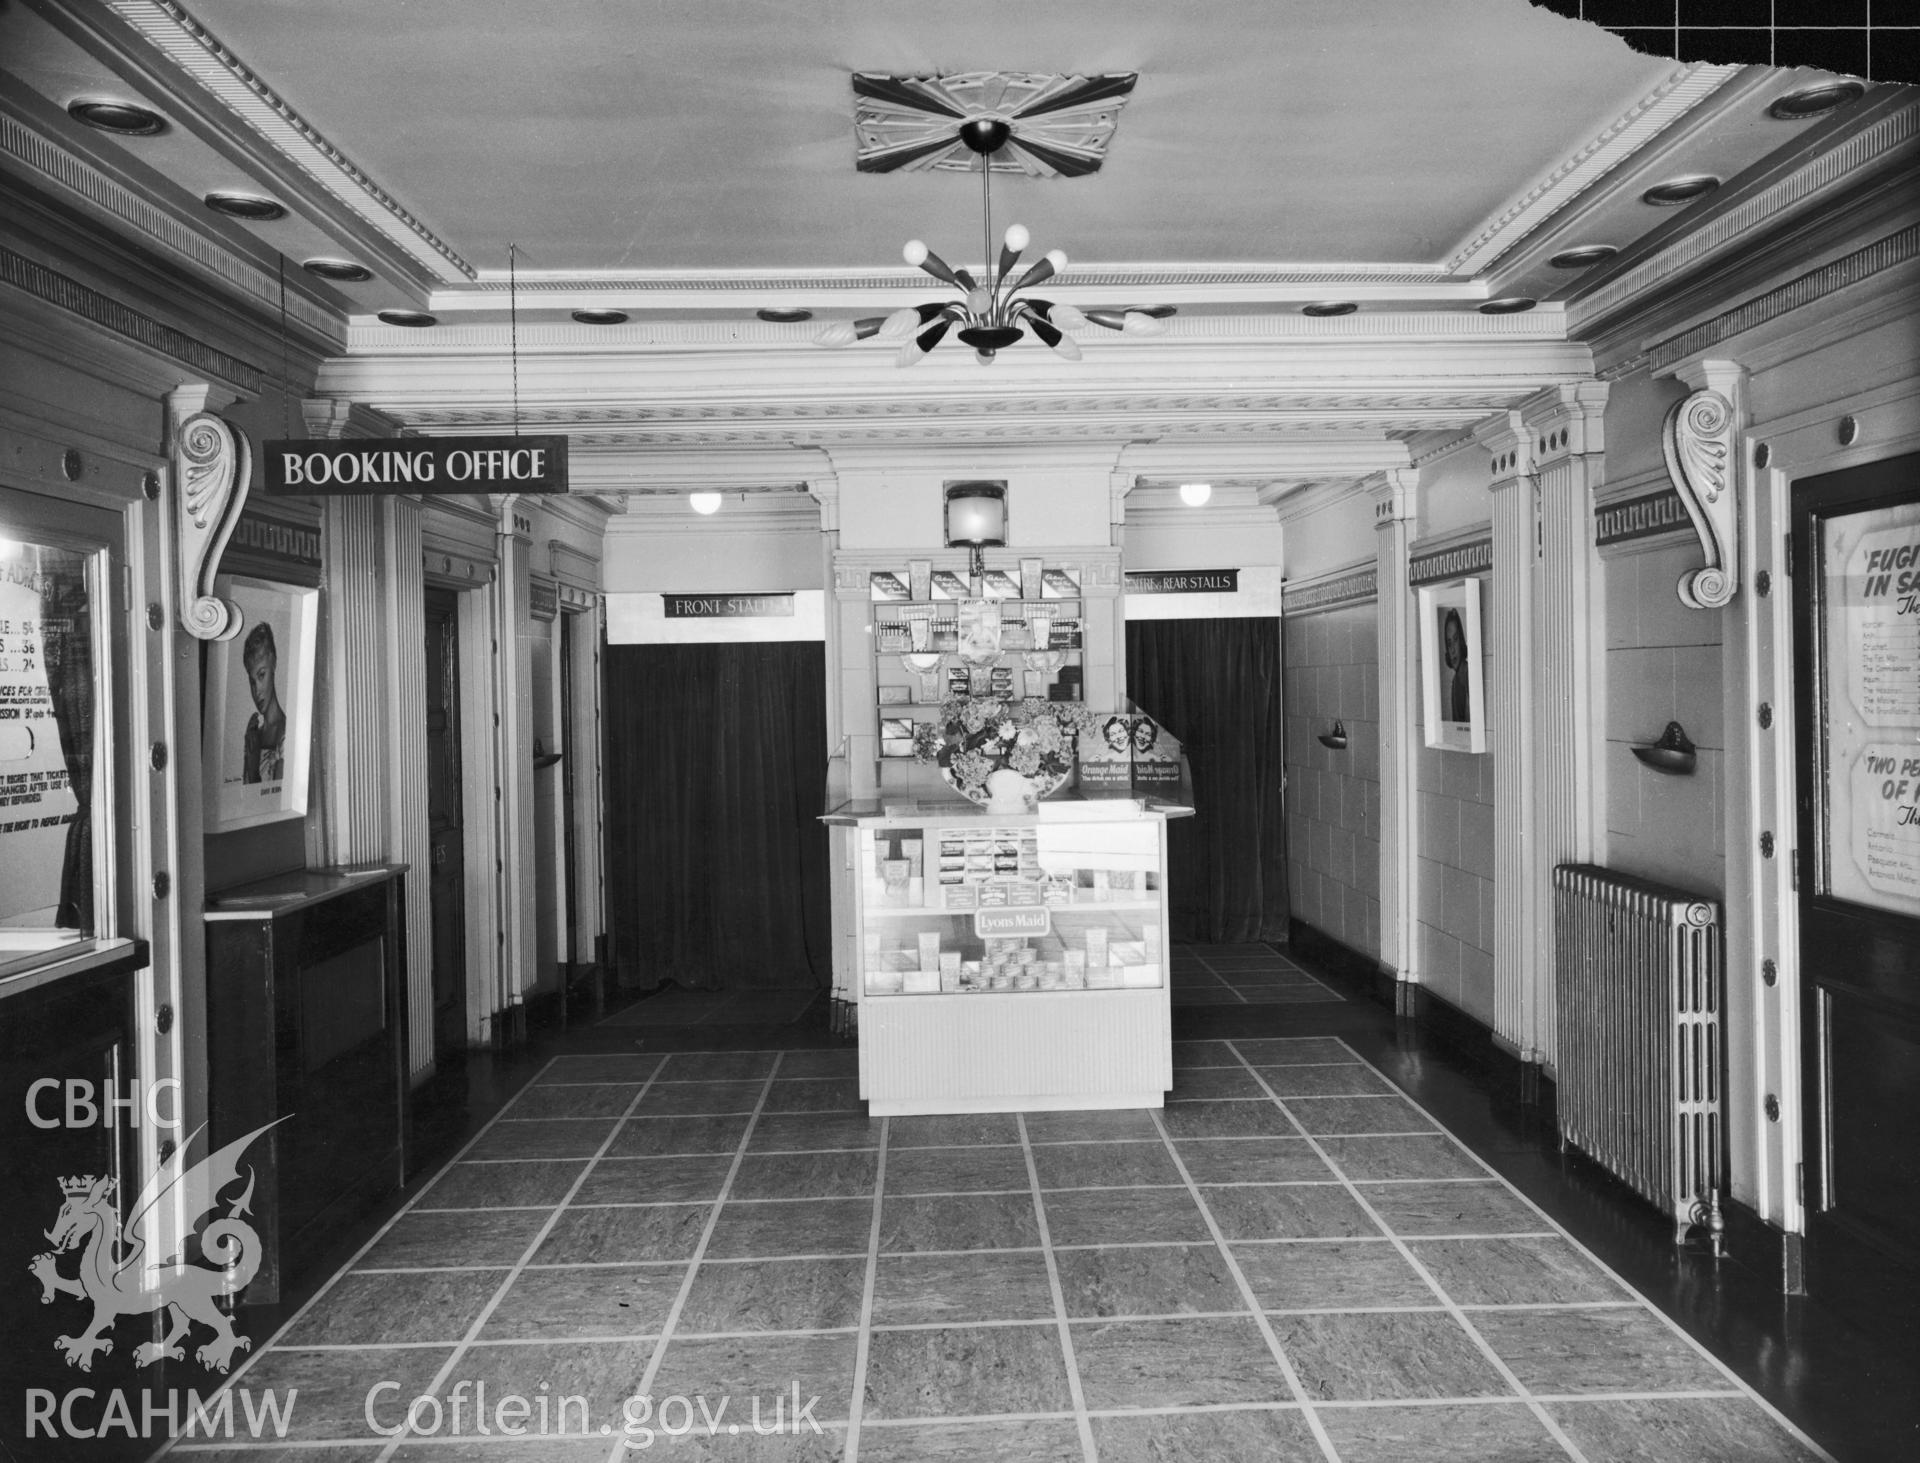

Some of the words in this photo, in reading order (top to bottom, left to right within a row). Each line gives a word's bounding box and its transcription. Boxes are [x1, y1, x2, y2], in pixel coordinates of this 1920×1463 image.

[281, 451, 435, 485] BOOKING
[446, 449, 545, 481] OFFICE
[1163, 576, 1188, 590] REAR
[1190, 575, 1231, 589] STALLS
[1864, 574, 1892, 598] IN
[675, 599, 722, 615] FRONT
[1082, 764, 1108, 776] Orange
[1109, 763, 1128, 774] Maid
[7, 773, 28, 784] REGRET
[30, 772, 44, 782] THAT
[29, 782, 48, 792] AFTER
[50, 780, 61, 790] USE
[1882, 779, 1909, 801] OF
[14, 819, 31, 832] RIGHT
[31, 818, 39, 829] TO
[981, 915, 1014, 931] Lyons
[1015, 914, 1045, 927] Maid
